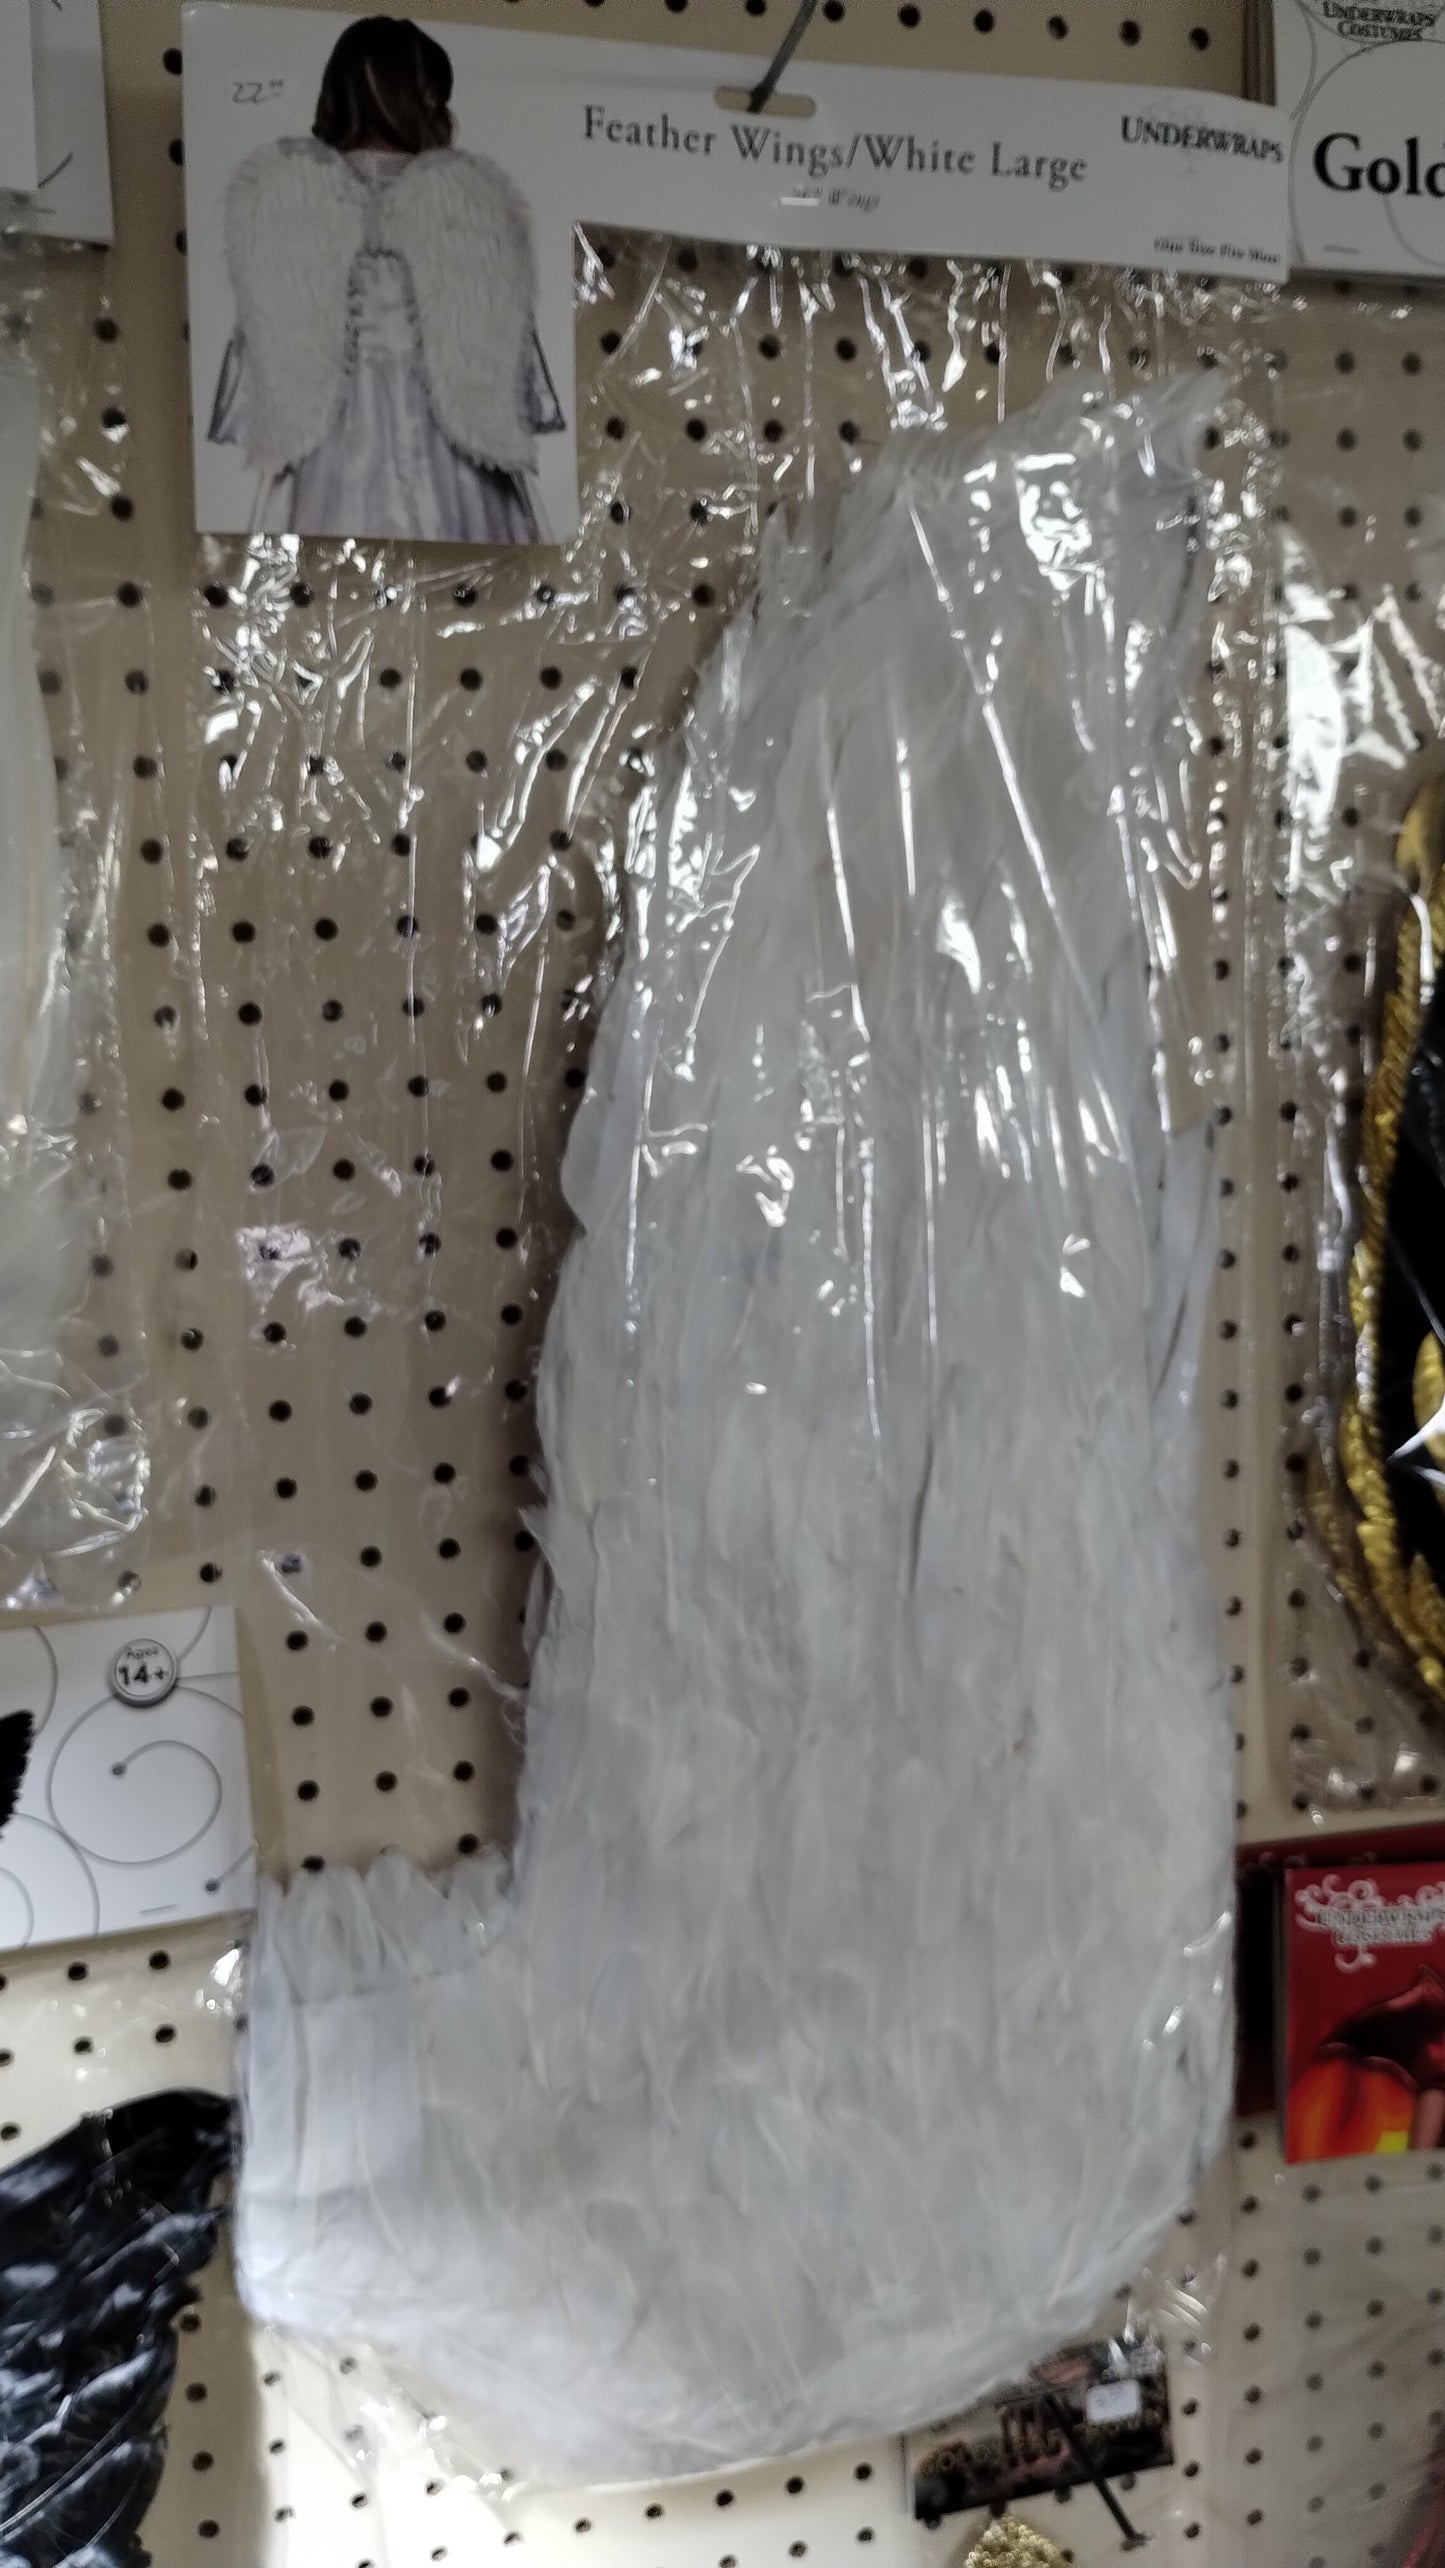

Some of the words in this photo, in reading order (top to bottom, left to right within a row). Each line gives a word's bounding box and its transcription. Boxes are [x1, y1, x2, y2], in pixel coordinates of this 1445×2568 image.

[582, 103, 717, 156] Feather
[730, 123, 976, 178] Wings/White
[990, 141, 1089, 192] Large
[118, 1664, 167, 1686] 14+
